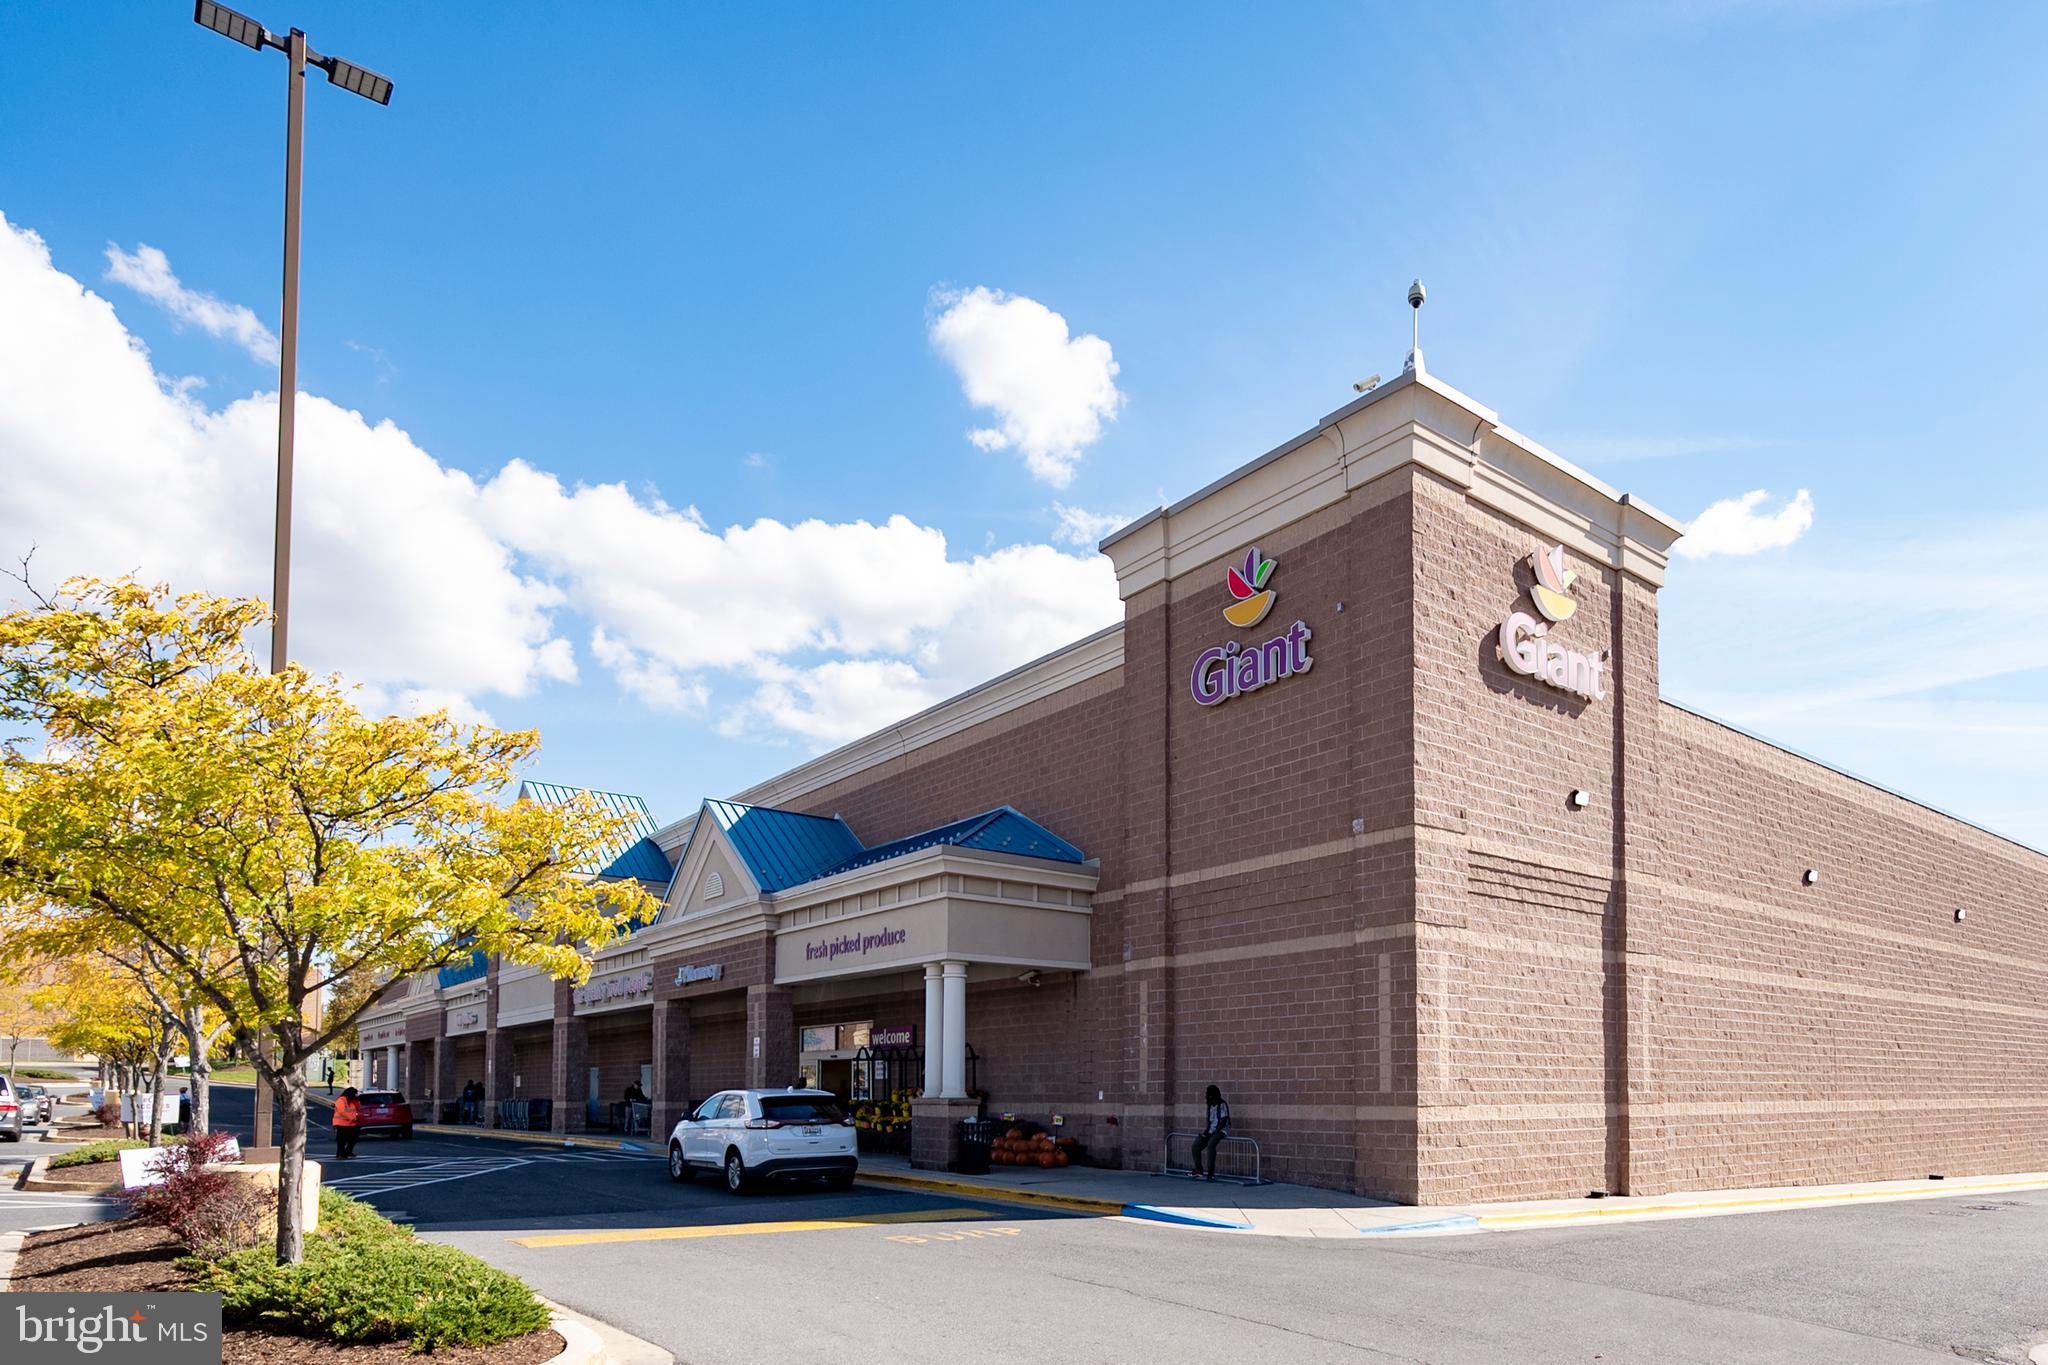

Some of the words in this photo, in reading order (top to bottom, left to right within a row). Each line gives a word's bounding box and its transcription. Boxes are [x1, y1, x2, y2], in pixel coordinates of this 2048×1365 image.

[1190, 620, 1313, 706] Giant
[1499, 611, 1607, 700] Giant
[806, 941, 829, 961] fresh
[829, 932, 861, 961] picked
[863, 927, 906, 955] produce
[872, 1028, 911, 1046] welcome
